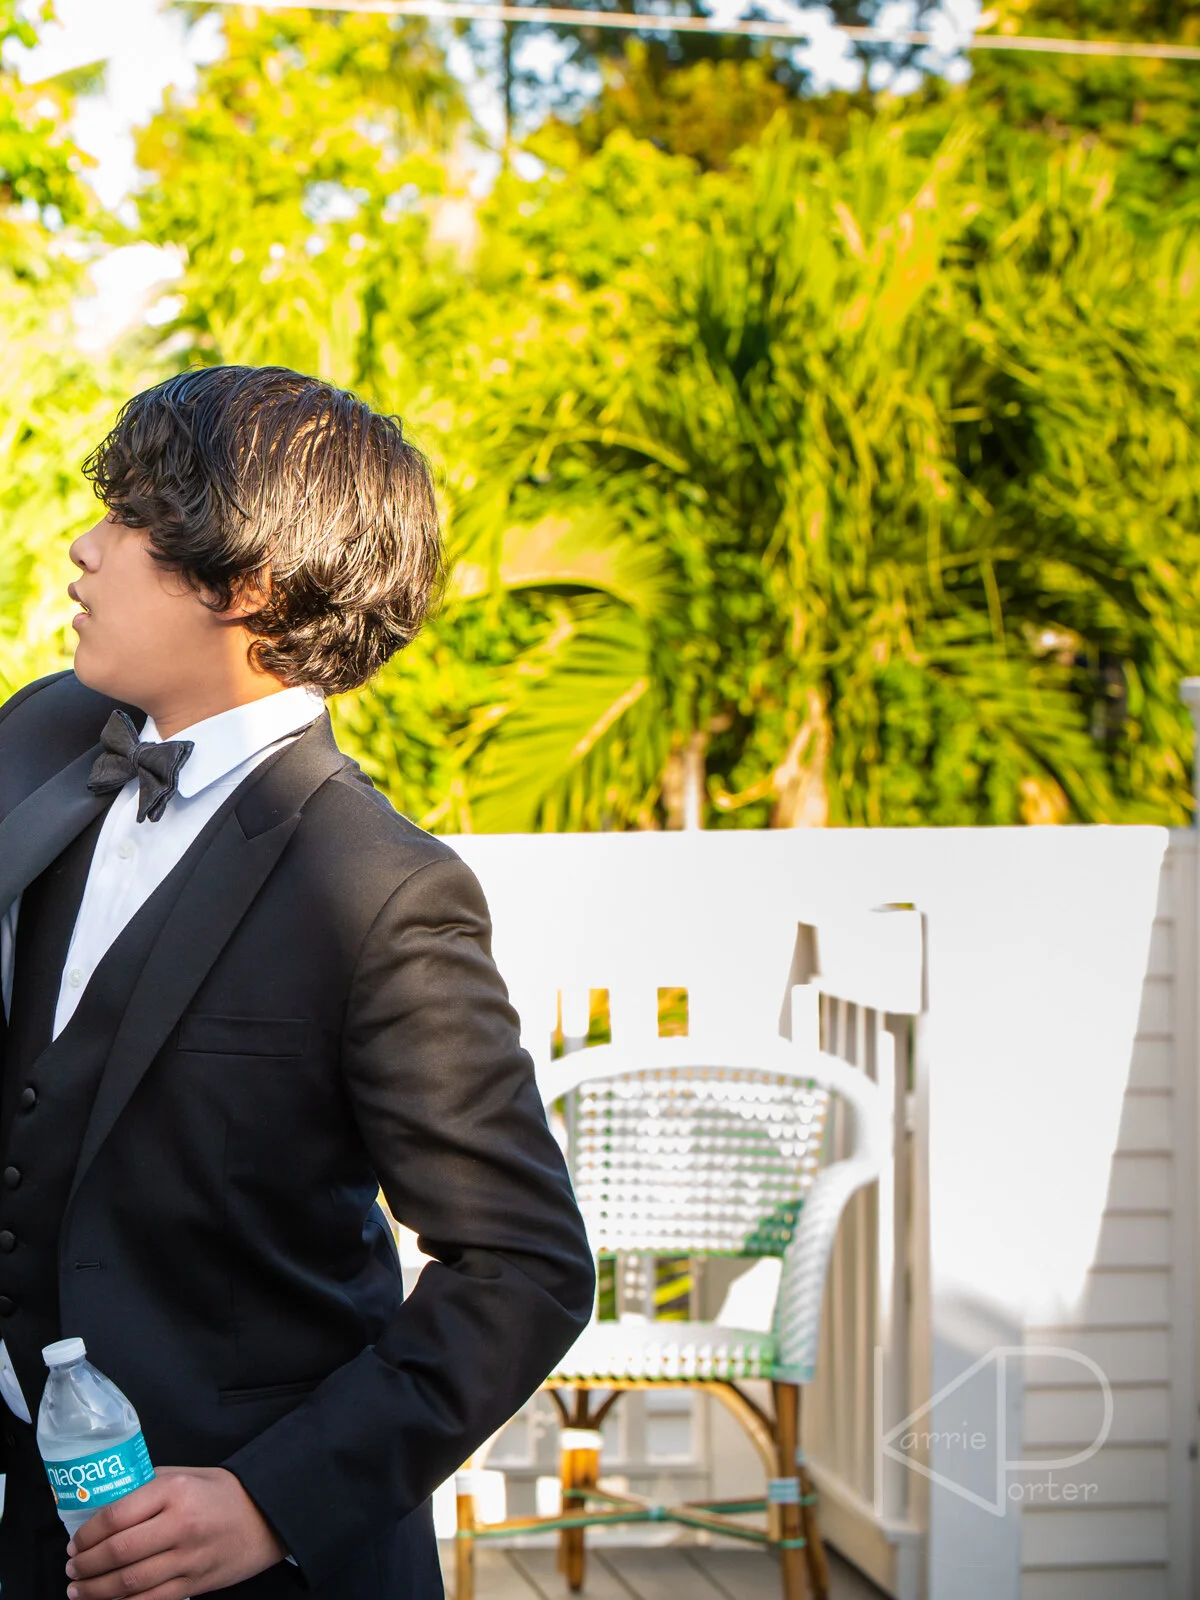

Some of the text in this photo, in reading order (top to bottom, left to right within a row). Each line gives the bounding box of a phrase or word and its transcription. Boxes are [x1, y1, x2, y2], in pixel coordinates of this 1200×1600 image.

[47, 1454, 125, 1501] niagara
[93, 1483, 114, 1494] SPRING
[114, 1475, 132, 1488] WATER
